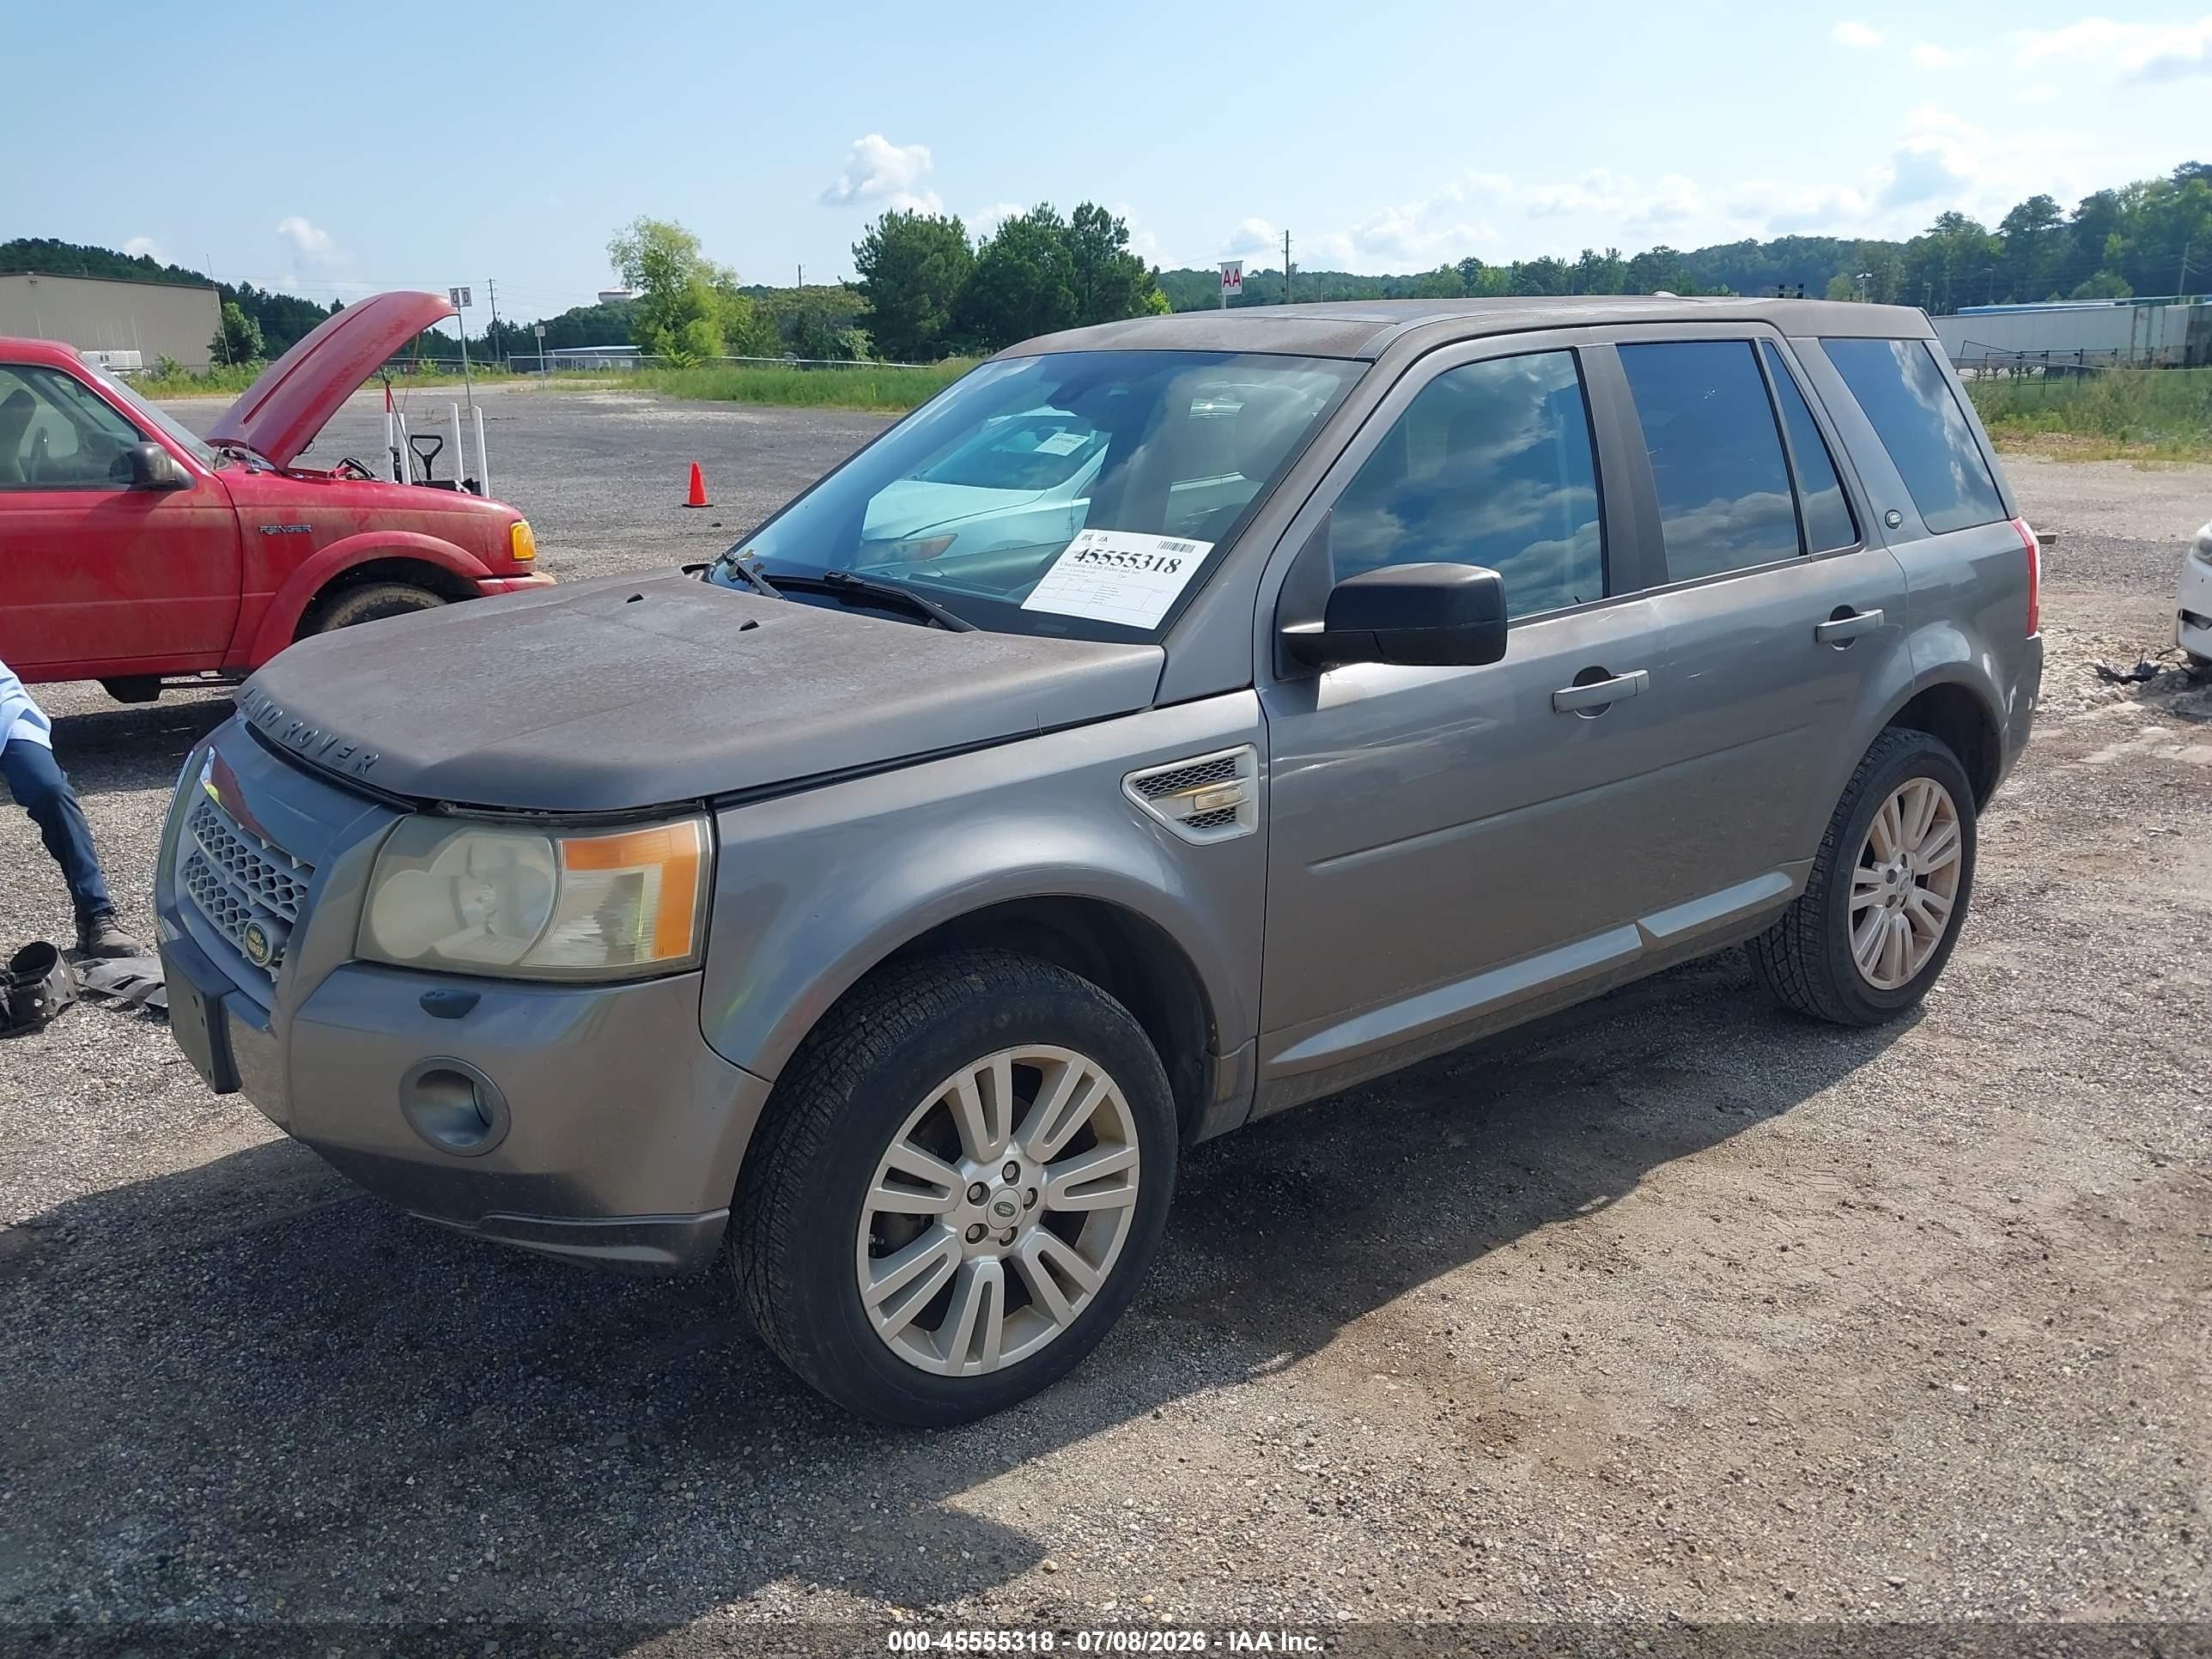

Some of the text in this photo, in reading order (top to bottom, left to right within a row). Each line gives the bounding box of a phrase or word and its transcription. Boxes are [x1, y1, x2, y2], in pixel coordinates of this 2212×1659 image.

[1223, 268, 1241, 288] AA
[259, 525, 312, 535] RANGER
[1073, 548, 1182, 574] 45555318
[282, 720, 380, 775] ROVER
